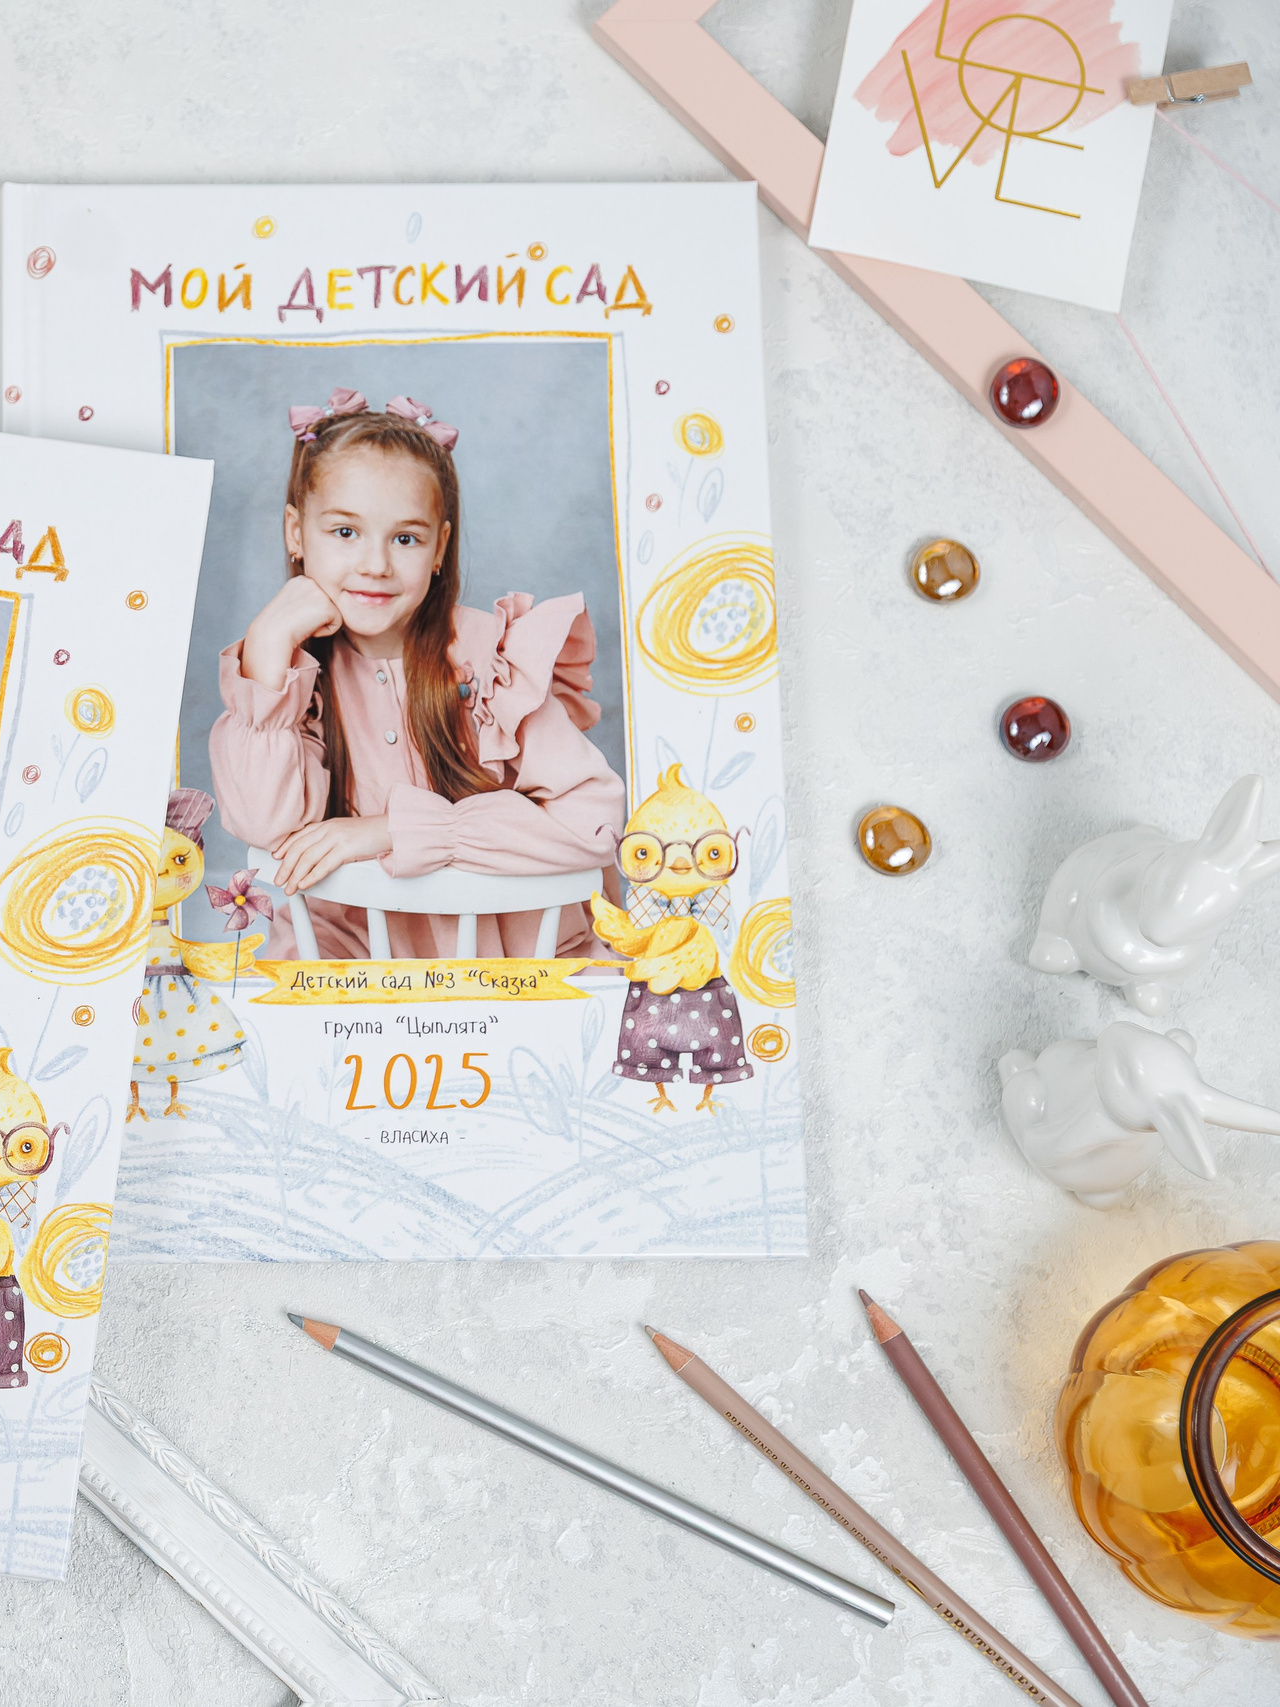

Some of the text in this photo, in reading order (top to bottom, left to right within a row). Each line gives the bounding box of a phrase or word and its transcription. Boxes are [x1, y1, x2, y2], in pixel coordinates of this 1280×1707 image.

[130, 252, 653, 323] МОЙ ДЕТСКИЙ САД
[290, 969, 549, 996] Детский сад №3 “Сказка”
[324, 1015, 499, 1040] группа “Цыплята”
[344, 1052, 492, 1111] 2025
[380, 1130, 450, 1145] ВЛАСИХА
[779, 1461, 811, 1492] WATER
[811, 1492, 850, 1527] COLOUR
[850, 1526, 889, 1563] PENCILS
